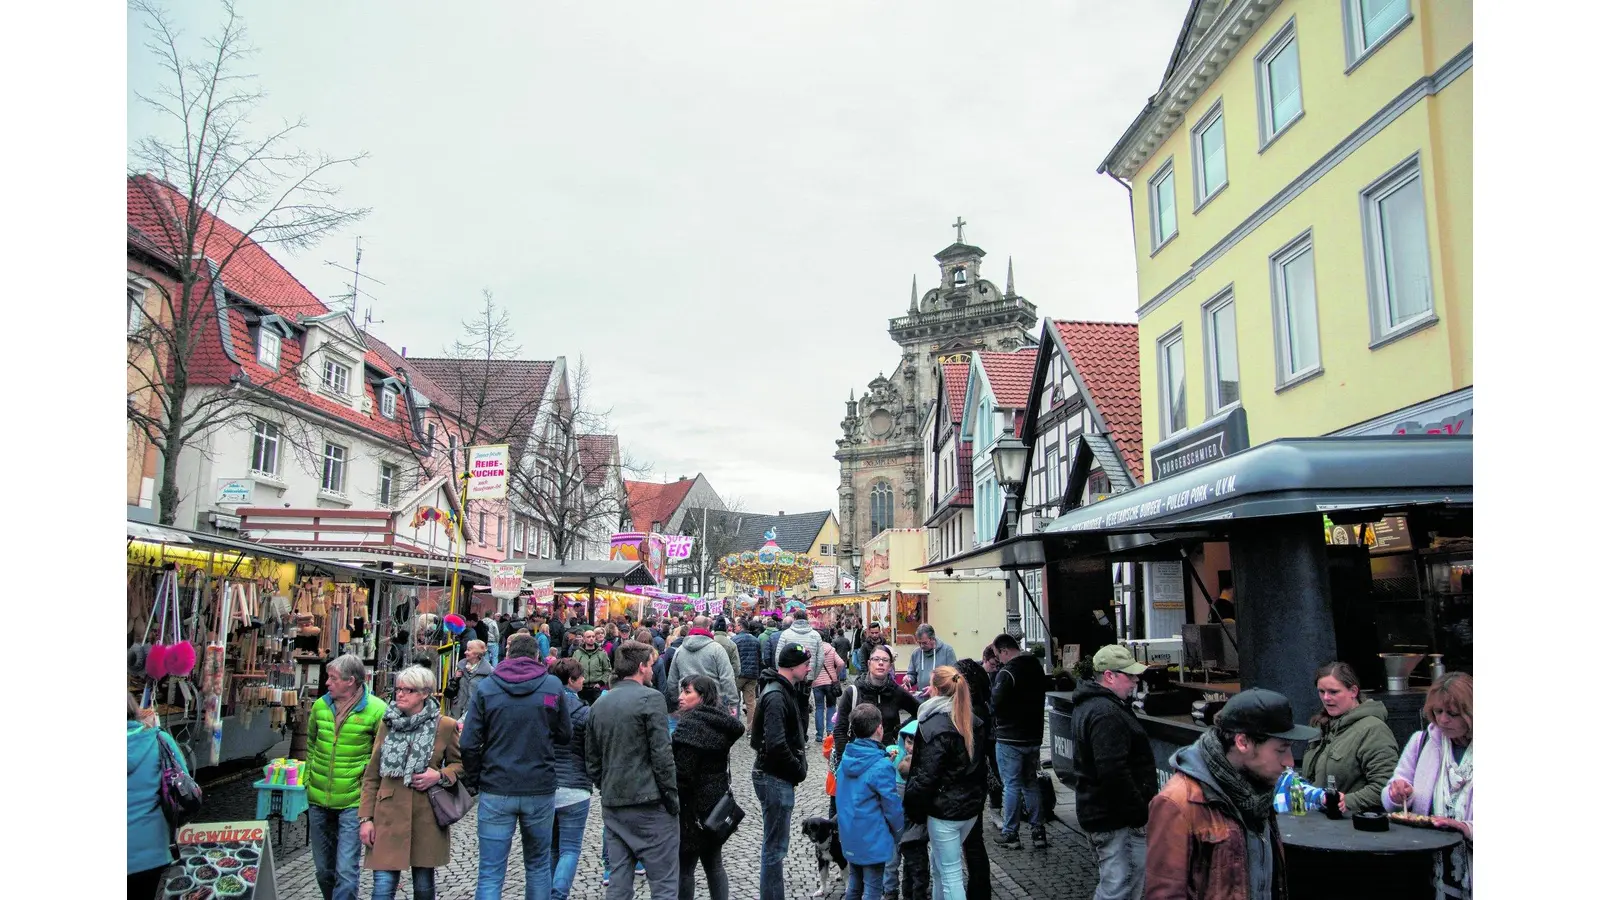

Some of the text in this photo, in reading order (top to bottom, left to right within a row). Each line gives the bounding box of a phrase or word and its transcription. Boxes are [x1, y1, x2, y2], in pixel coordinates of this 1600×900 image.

[475, 460, 503, 468] REIBE-
[1162, 443, 1218, 474] BURGERSCHMIED
[471, 469, 504, 478] KUCHEN
[1166, 489, 1190, 511] PULLED
[1190, 484, 1208, 504] PORK
[1215, 475, 1236, 496] U.V.M.
[668, 543, 691, 556] EIS
[179, 825, 263, 844] Gewürze
